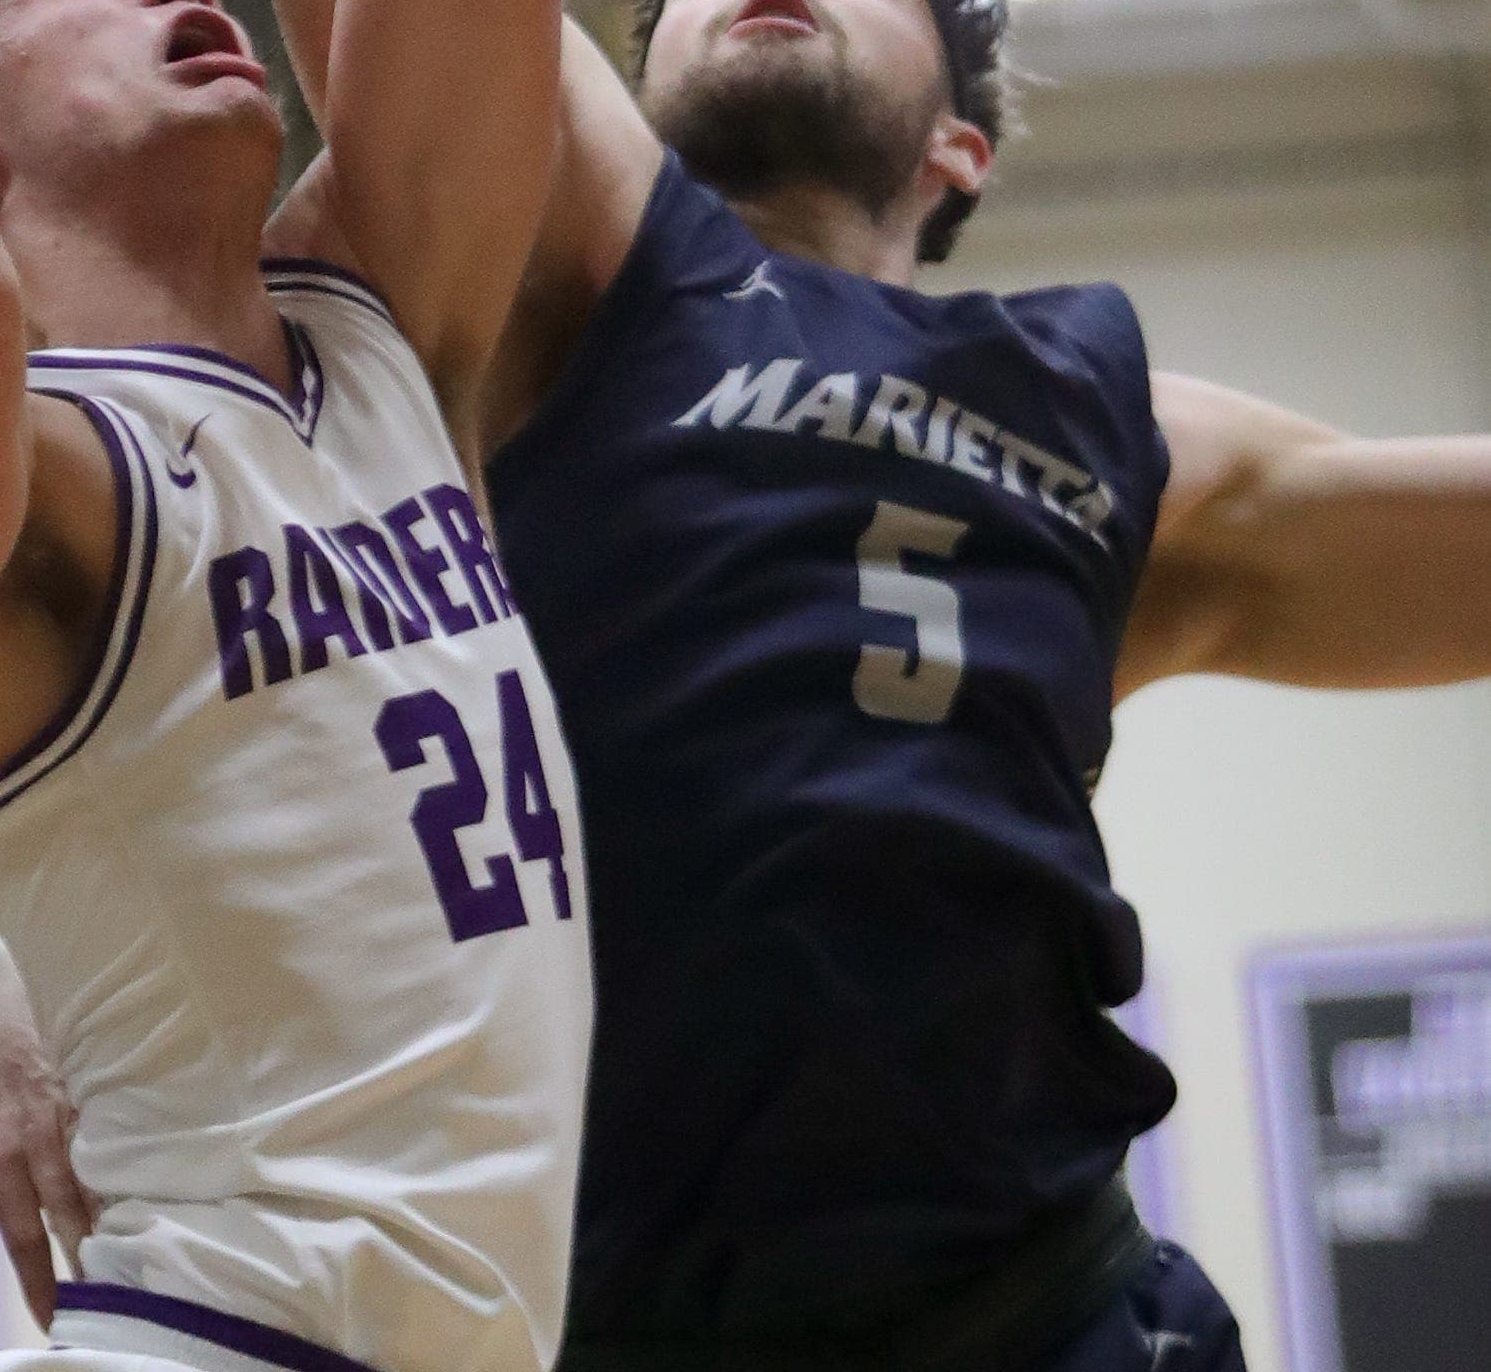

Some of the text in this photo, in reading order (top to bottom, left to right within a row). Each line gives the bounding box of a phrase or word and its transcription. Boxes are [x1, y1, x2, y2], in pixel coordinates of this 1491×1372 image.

[208, 482, 519, 702] RAIDER
[852, 499, 971, 725] 5
[373, 668, 573, 943] 24
